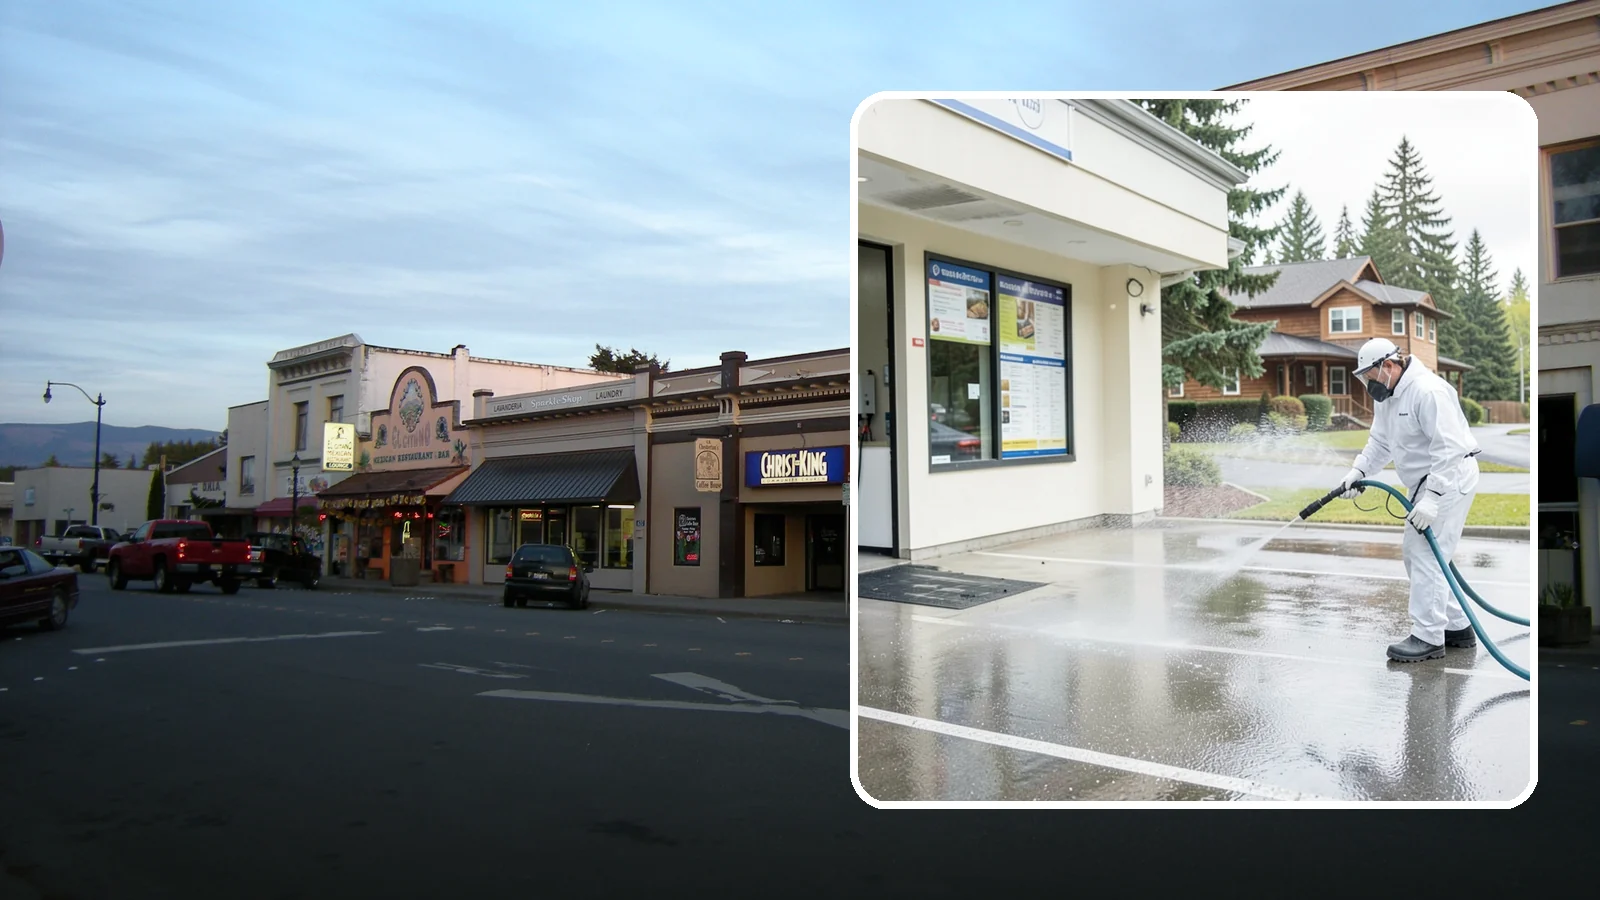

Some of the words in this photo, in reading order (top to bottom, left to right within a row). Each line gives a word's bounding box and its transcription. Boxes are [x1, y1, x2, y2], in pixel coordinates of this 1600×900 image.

[595, 388, 624, 400] LAUNDRY
[493, 401, 523, 413] LAVANDERIA
[530, 398, 561, 410] Sparkle
[561, 394, 583, 406] Shop
[373, 454, 396, 464] MEXICAN
[397, 451, 434, 462] RESTAURANT
[438, 450, 450, 459] BAR
[760, 452, 797, 478] CHRIST
[799, 450, 827, 476] KING
[696, 481, 709, 489] Coffee
